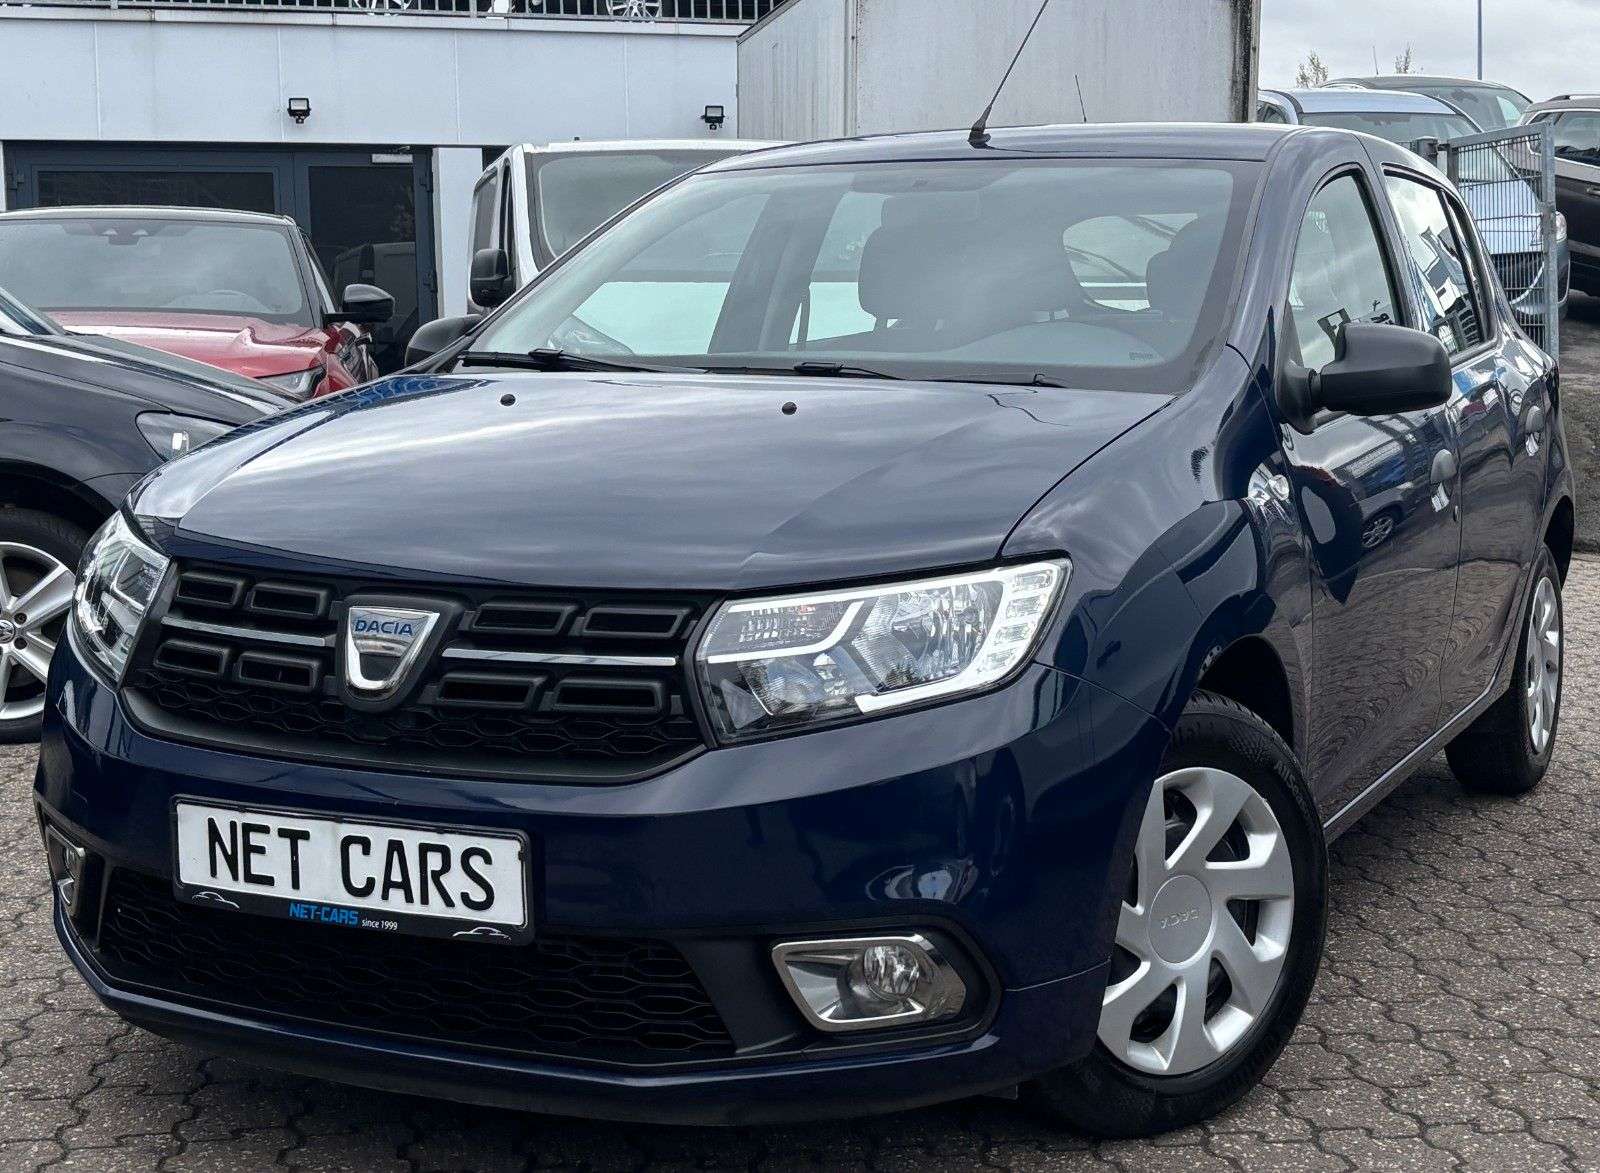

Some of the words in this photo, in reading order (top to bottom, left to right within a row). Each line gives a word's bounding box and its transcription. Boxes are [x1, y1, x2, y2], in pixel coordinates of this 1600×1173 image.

[354, 619, 413, 635] DACIA
[207, 817, 311, 890] NET
[340, 834, 496, 911] CARS
[289, 902, 359, 925] NET-CARS
[361, 918, 380, 929] since
[381, 920, 398, 931] 1999
